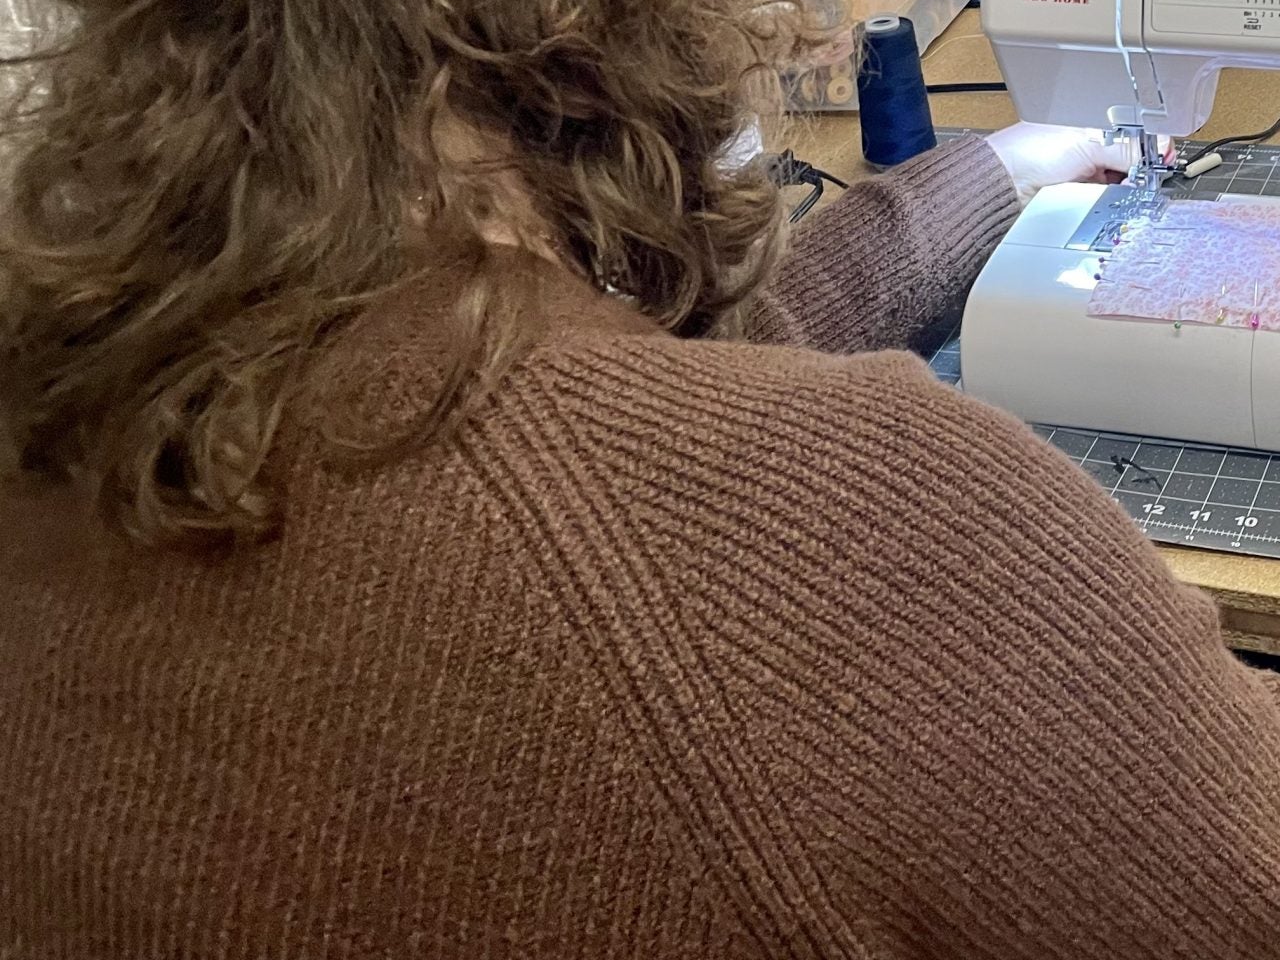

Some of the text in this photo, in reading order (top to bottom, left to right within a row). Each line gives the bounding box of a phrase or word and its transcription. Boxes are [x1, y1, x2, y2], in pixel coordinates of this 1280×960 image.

[1142, 503, 1166, 515] 12
[1189, 510, 1212, 522] 11
[1234, 515, 1258, 528] 10
